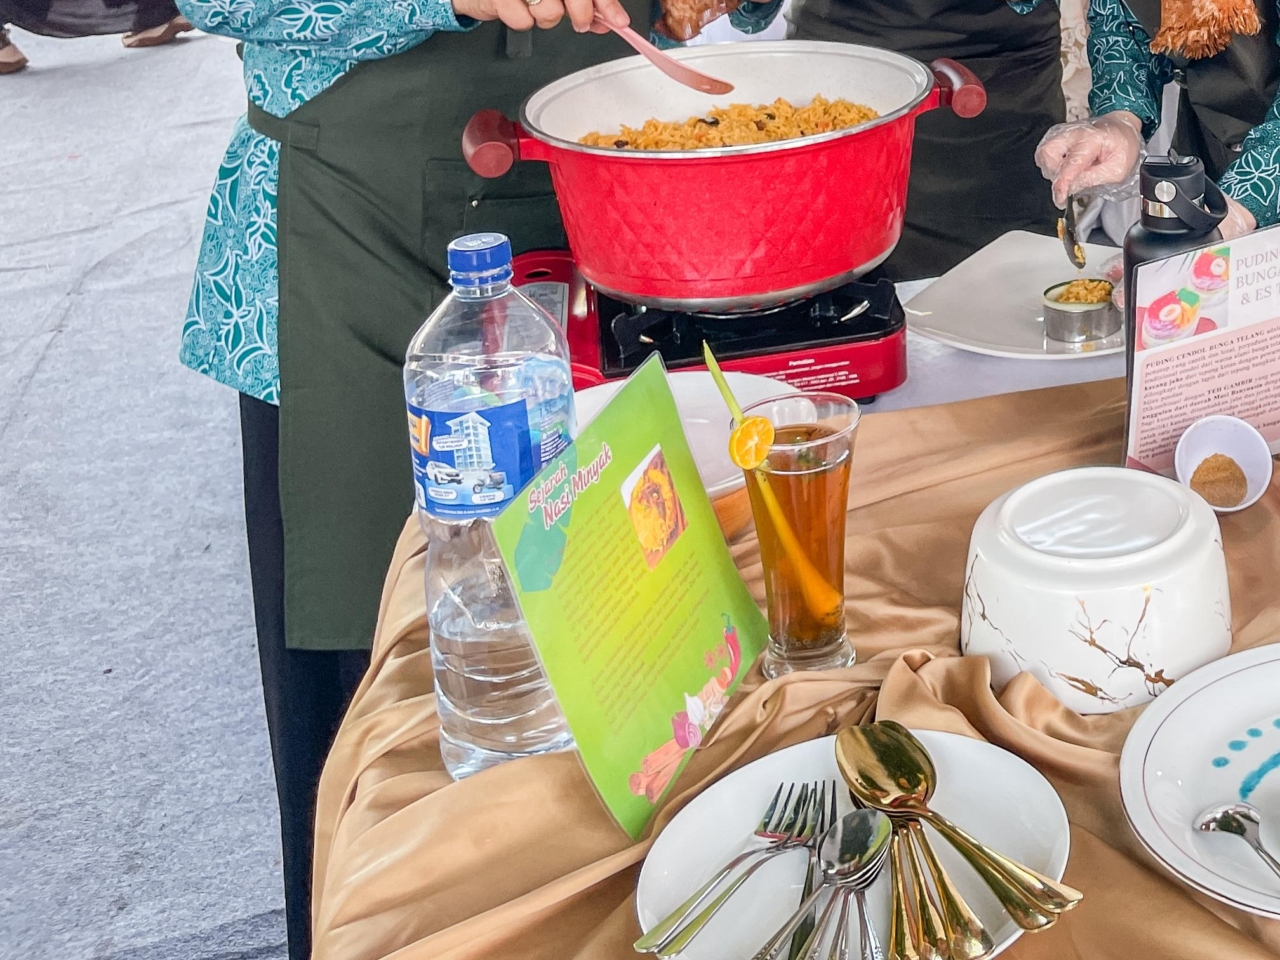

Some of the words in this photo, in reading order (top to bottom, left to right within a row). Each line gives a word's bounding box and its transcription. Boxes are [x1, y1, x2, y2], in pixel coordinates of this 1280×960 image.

[1240, 293, 1251, 305] &
[1255, 286, 1272, 301] ES
[1145, 356, 1174, 368] PUDING
[1175, 346, 1206, 360] CENDOL
[1208, 338, 1234, 350] BUNGA
[1235, 329, 1265, 342] TELANG
[1206, 386, 1222, 395] TEH
[1223, 377, 1252, 390] GAMBIR
[528, 461, 567, 513] Sejarah
[541, 484, 572, 529] Nasi
[571, 442, 612, 500] Minyak
